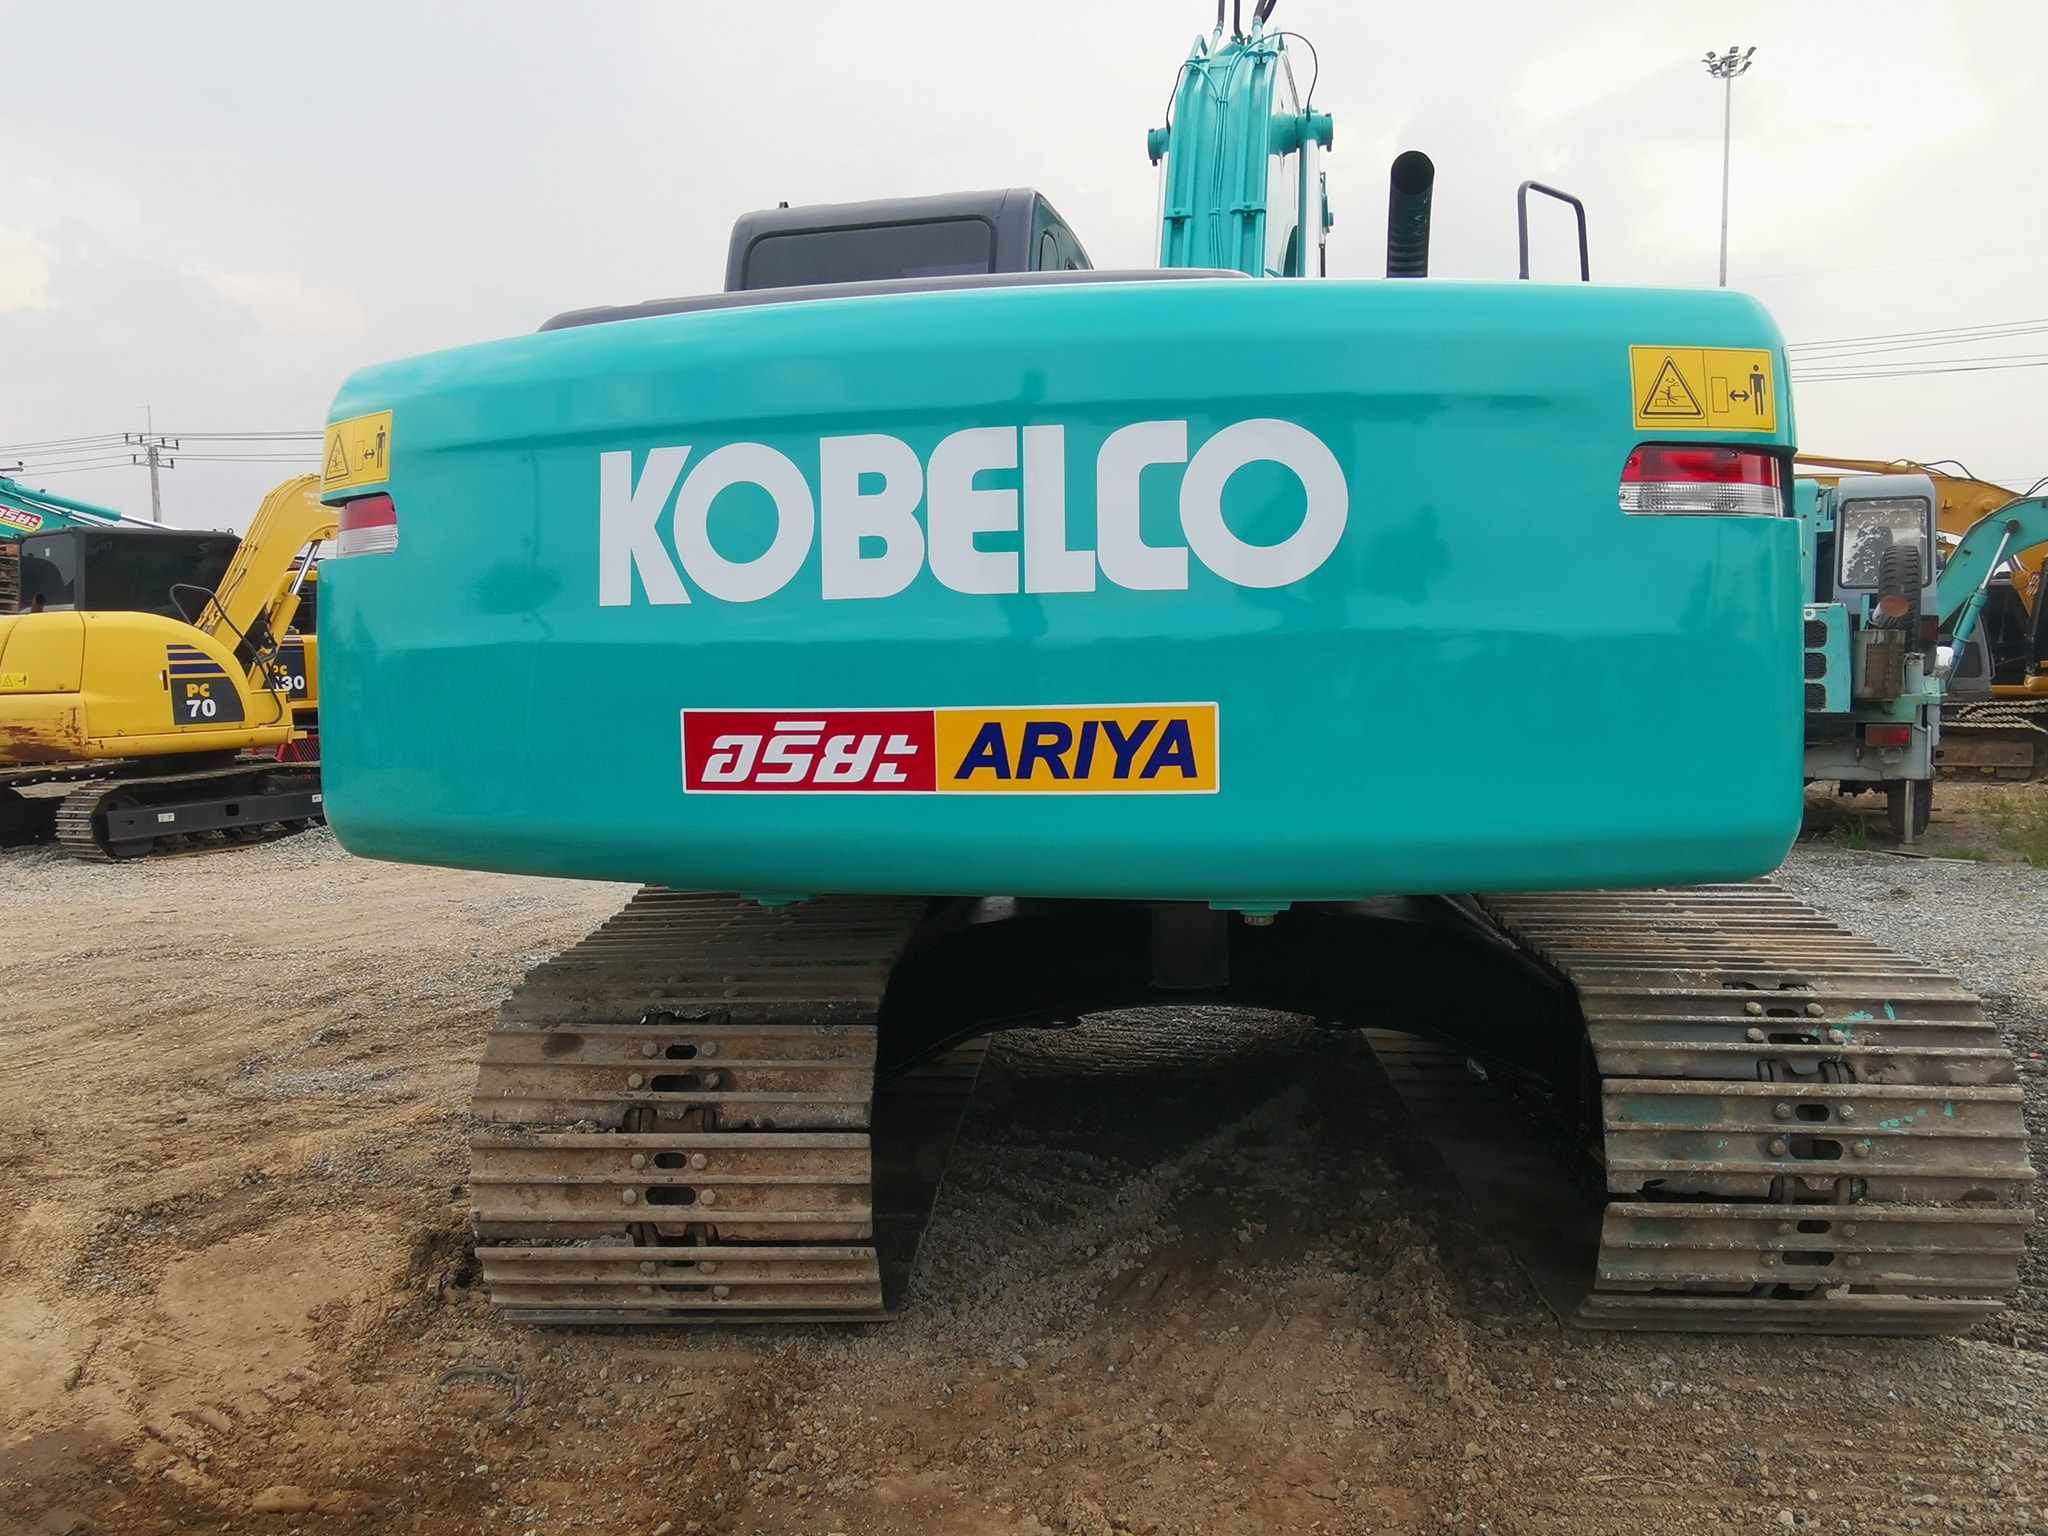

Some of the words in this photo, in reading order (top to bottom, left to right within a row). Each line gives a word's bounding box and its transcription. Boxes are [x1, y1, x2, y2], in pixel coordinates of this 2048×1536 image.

[600, 418, 1348, 606] KOBELCO
[186, 683, 210, 698] PC
[186, 699, 216, 717] 70
[701, 720, 919, 783] อริยะ
[953, 719, 1198, 780] ARIYA
